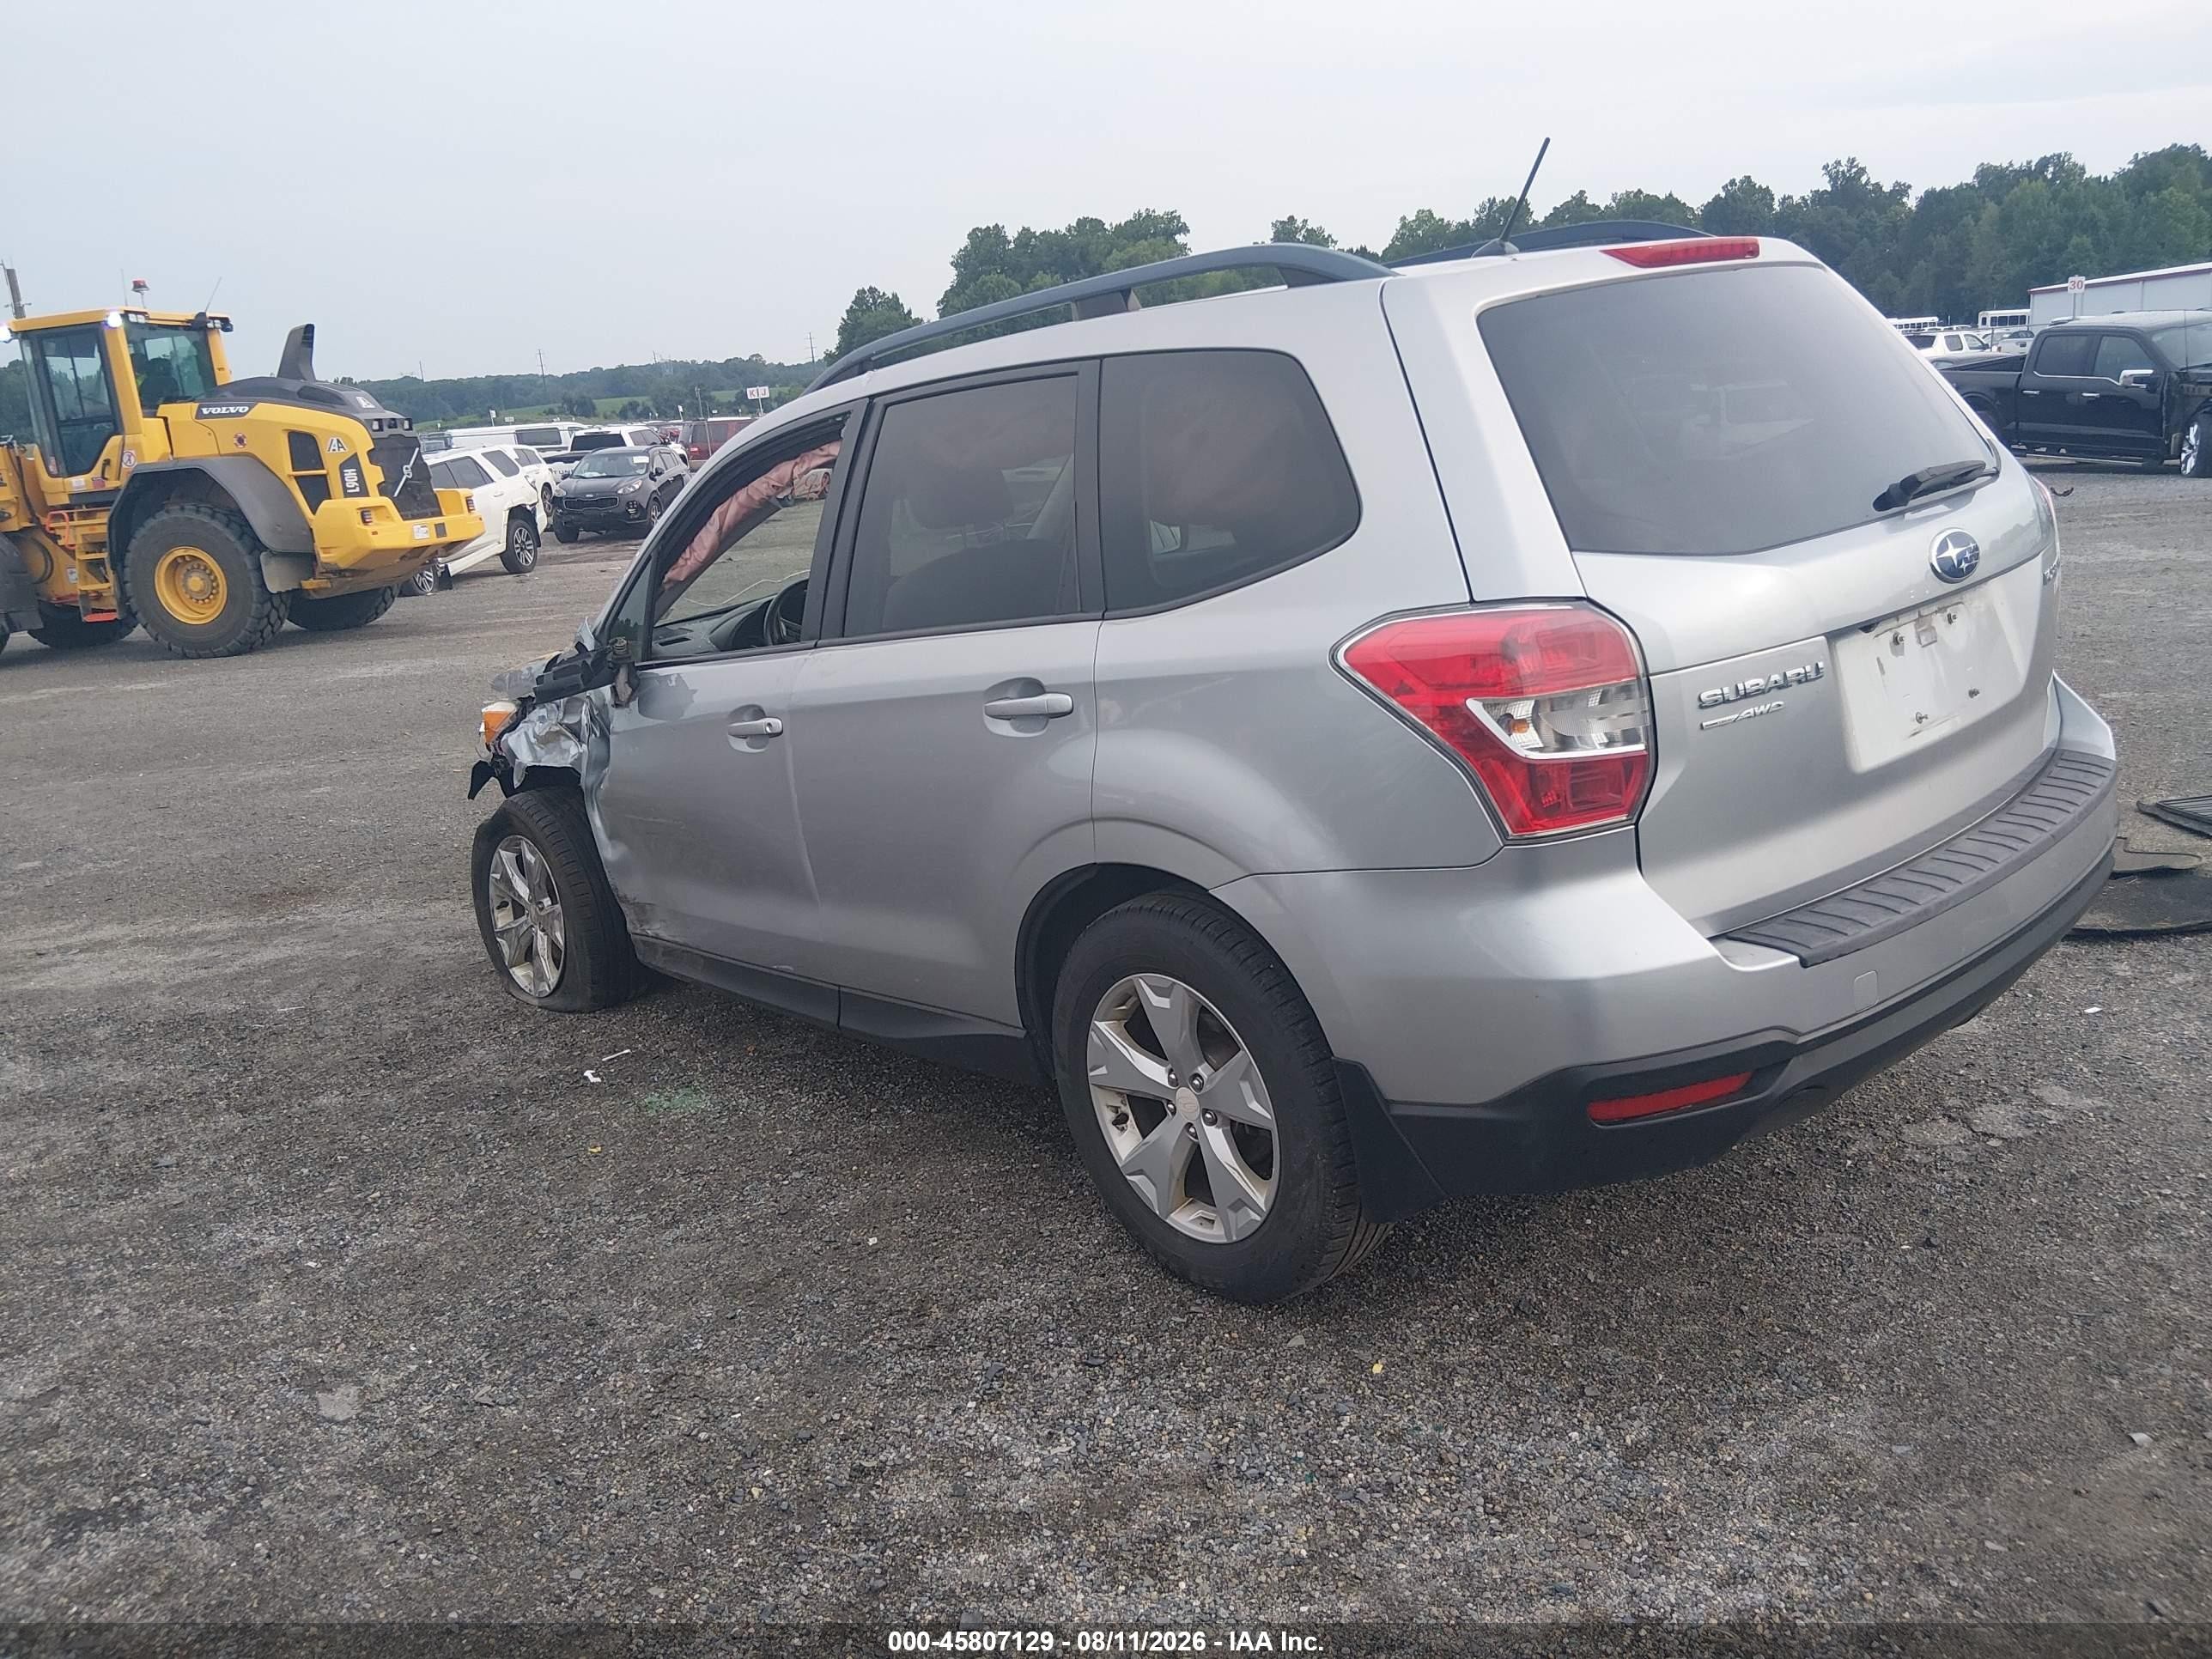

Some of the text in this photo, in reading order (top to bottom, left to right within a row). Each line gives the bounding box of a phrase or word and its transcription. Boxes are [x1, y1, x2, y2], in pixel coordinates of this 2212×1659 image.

[2069, 280, 2083, 290] 30
[201, 406, 249, 415] VOLVO
[343, 468, 360, 493] L90H
[1698, 660, 1825, 709] SUBARU
[1735, 700, 1784, 721] AWD
